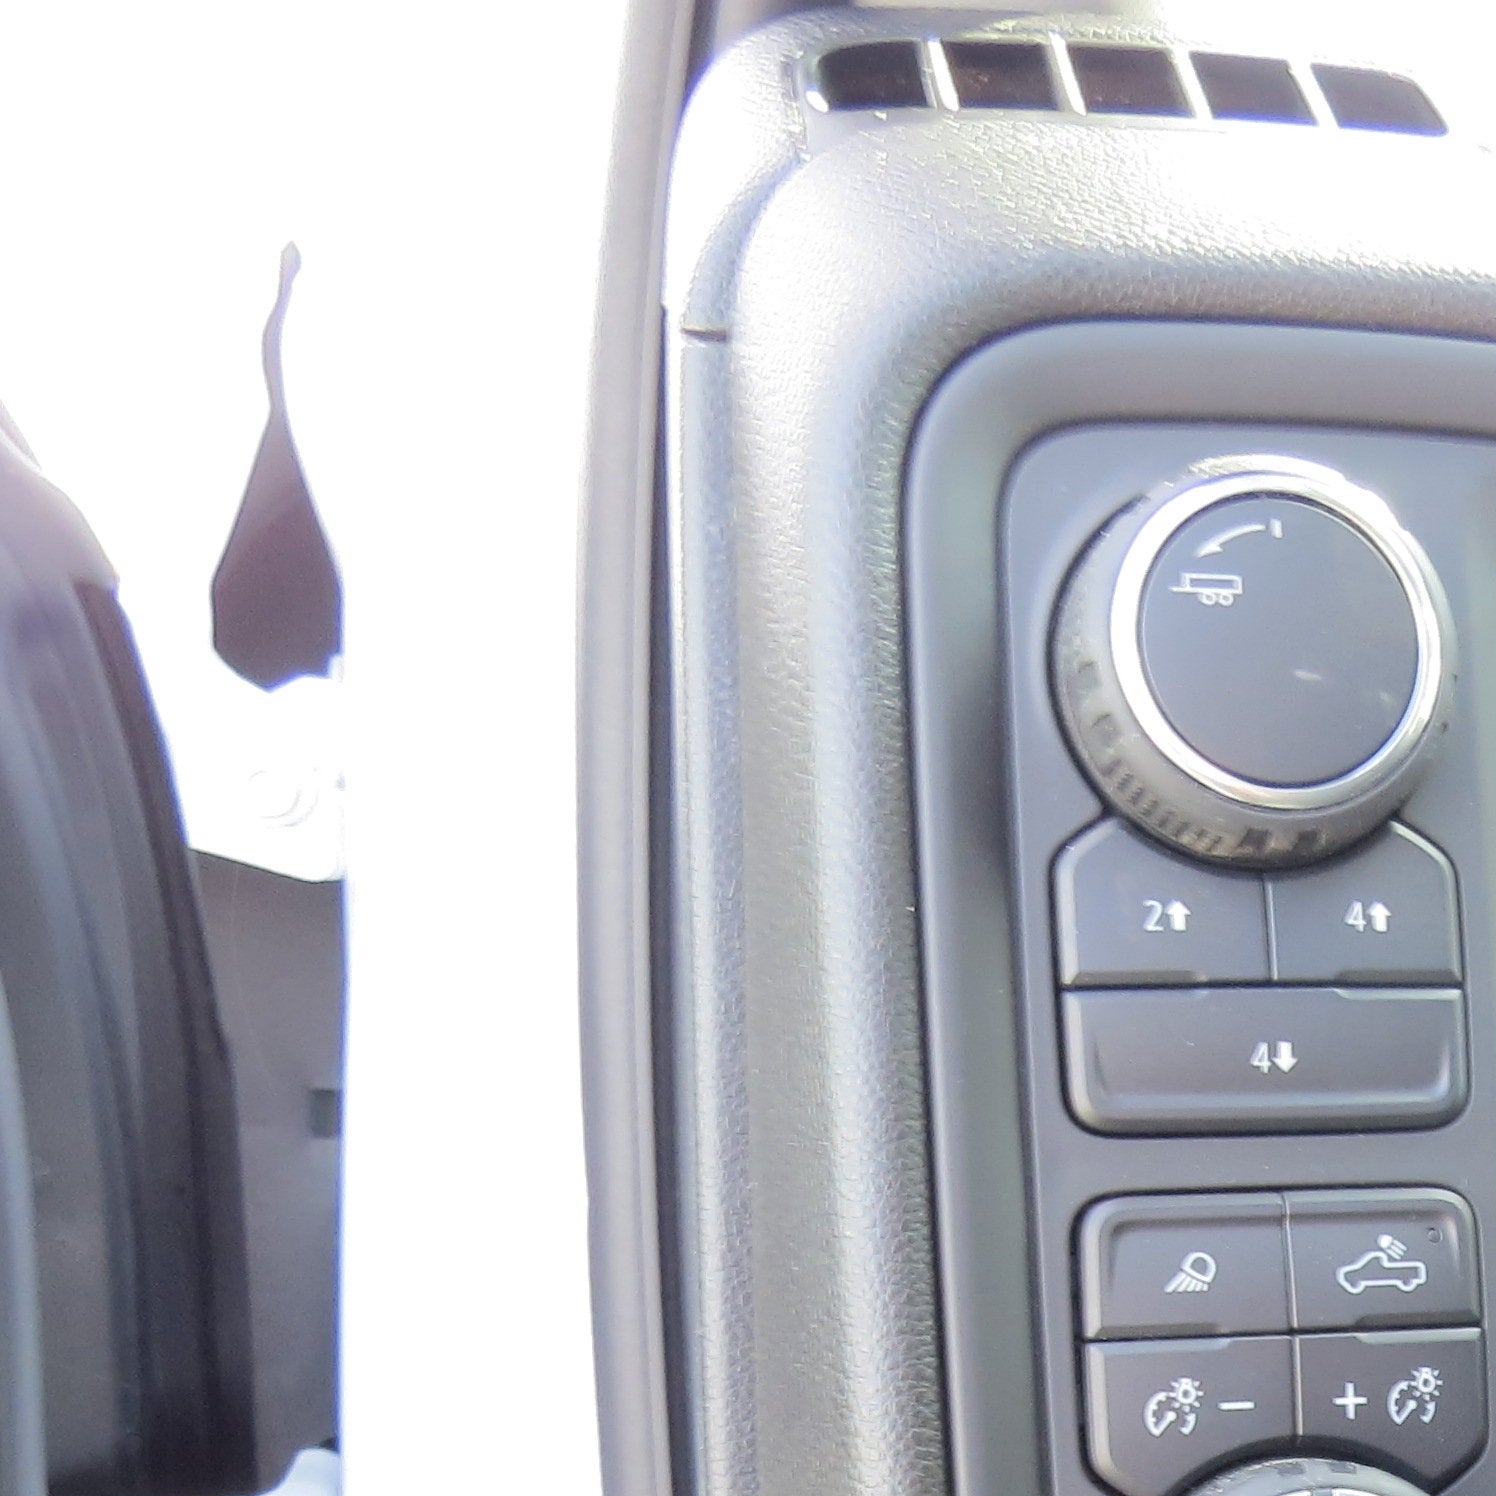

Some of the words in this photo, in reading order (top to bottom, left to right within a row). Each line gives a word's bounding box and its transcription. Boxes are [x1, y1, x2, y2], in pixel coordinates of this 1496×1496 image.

[1142, 900, 1164, 931] 2
[1344, 901, 1367, 933] 4
[1250, 1041, 1272, 1074] 4
